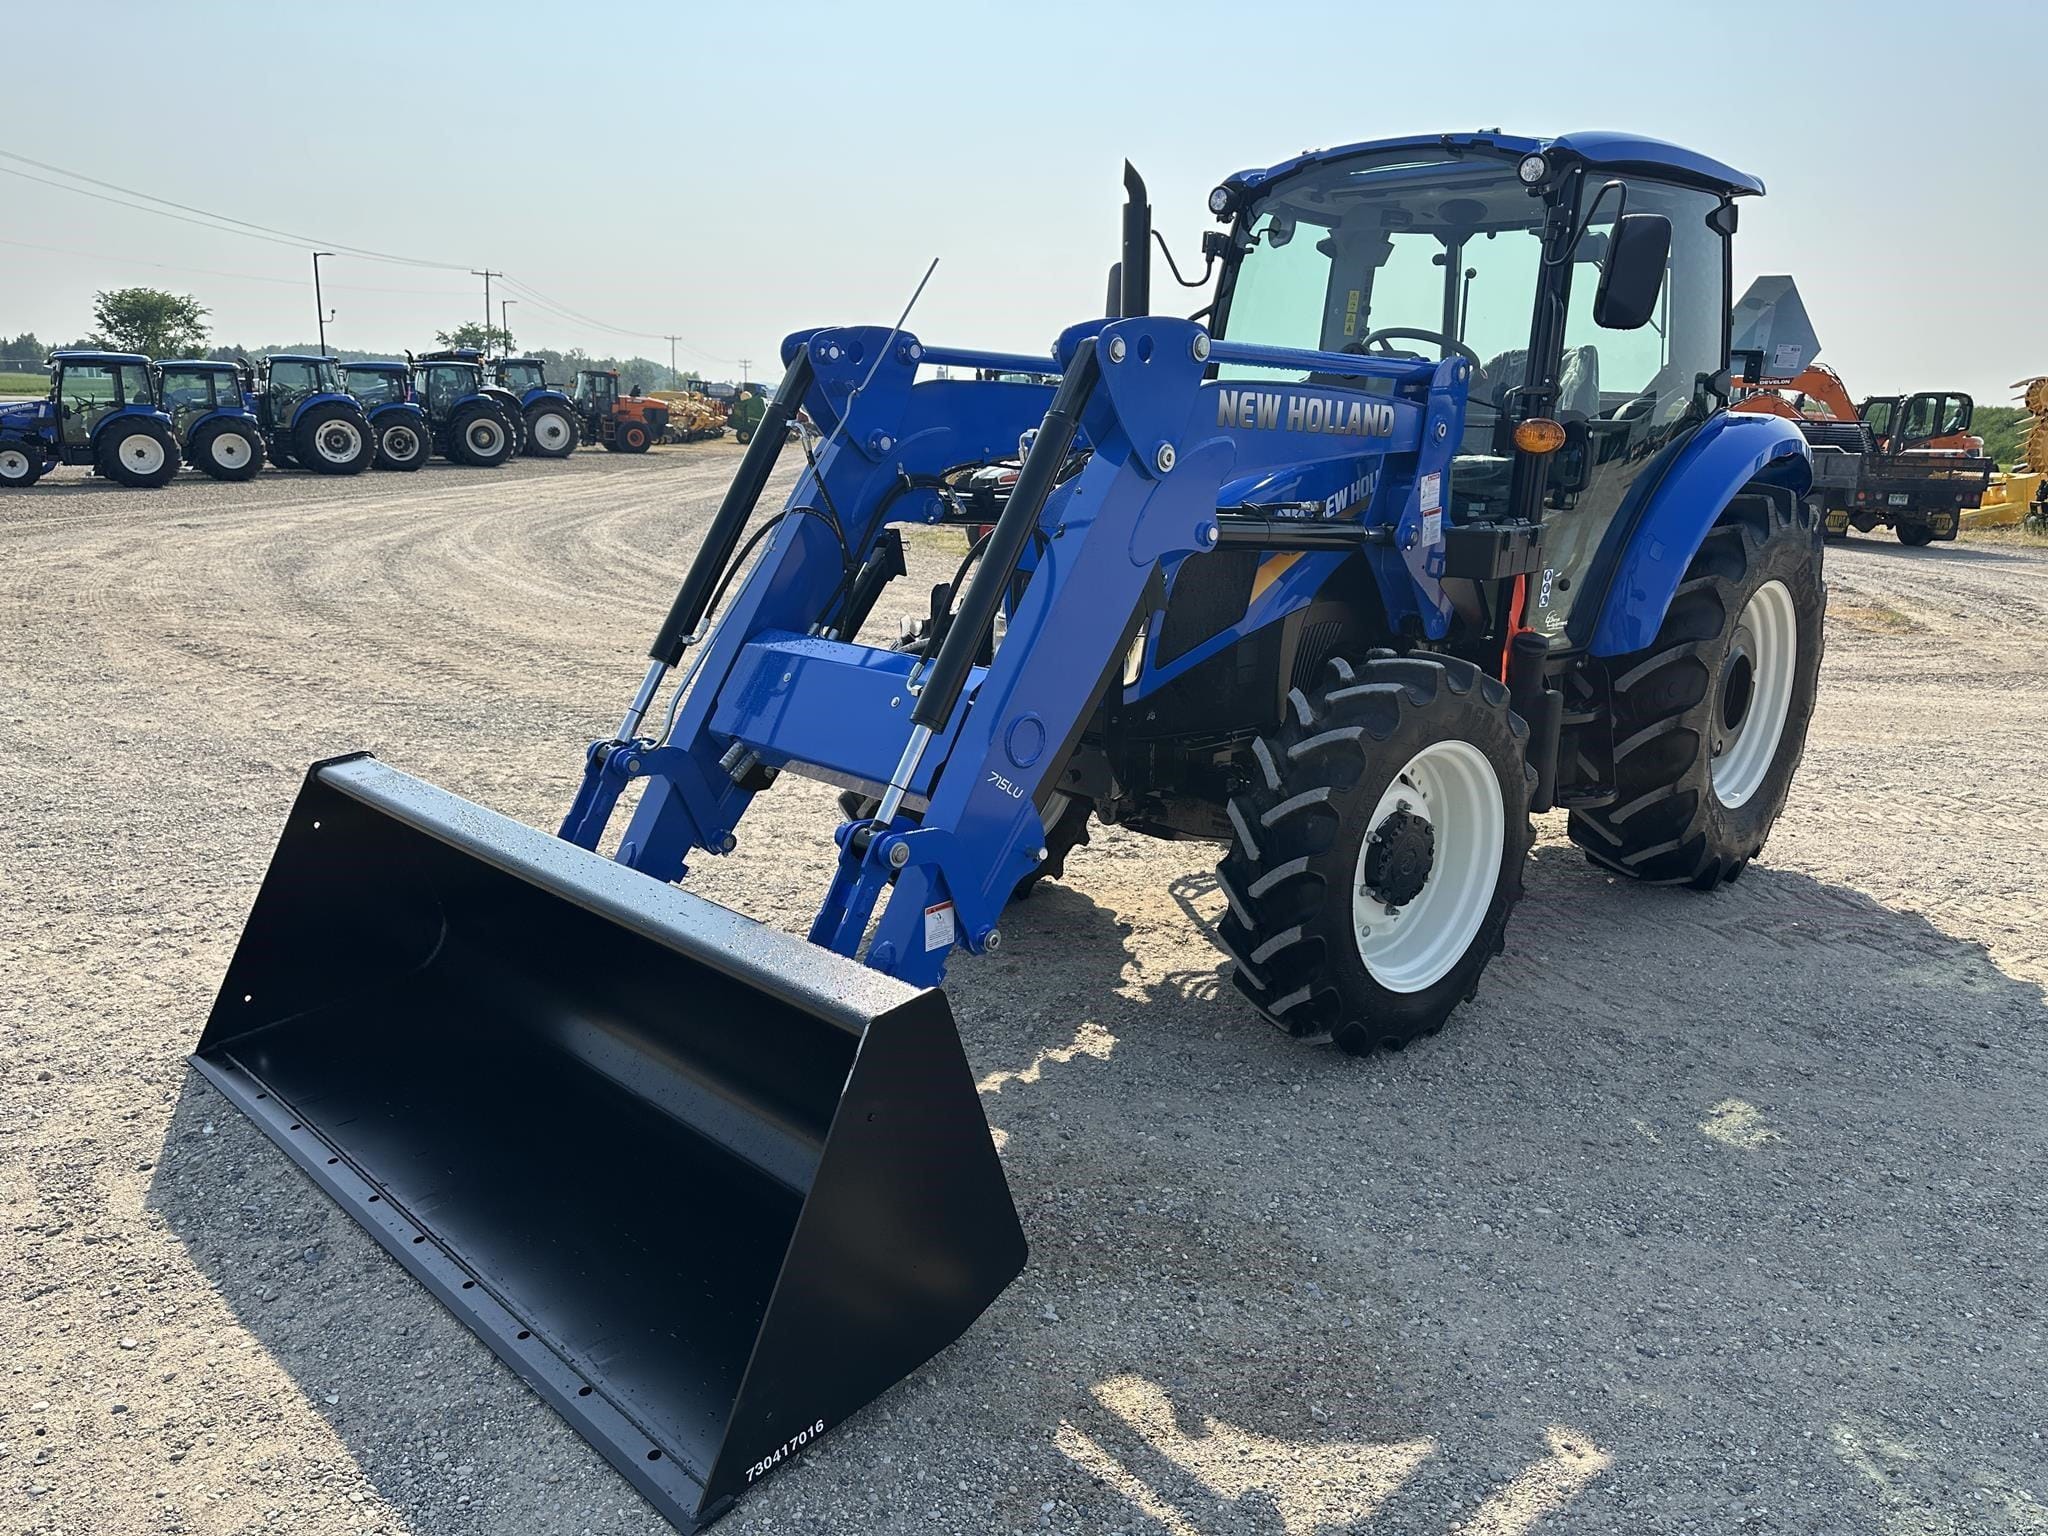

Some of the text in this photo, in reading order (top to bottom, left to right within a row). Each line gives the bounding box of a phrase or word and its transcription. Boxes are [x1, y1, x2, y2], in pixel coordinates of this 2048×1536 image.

[1216, 389, 1395, 437] NEW HOLLAND
[1323, 486, 1349, 519] EW
[987, 771, 1024, 799] 715LU
[745, 1419, 824, 1482] 730417016
